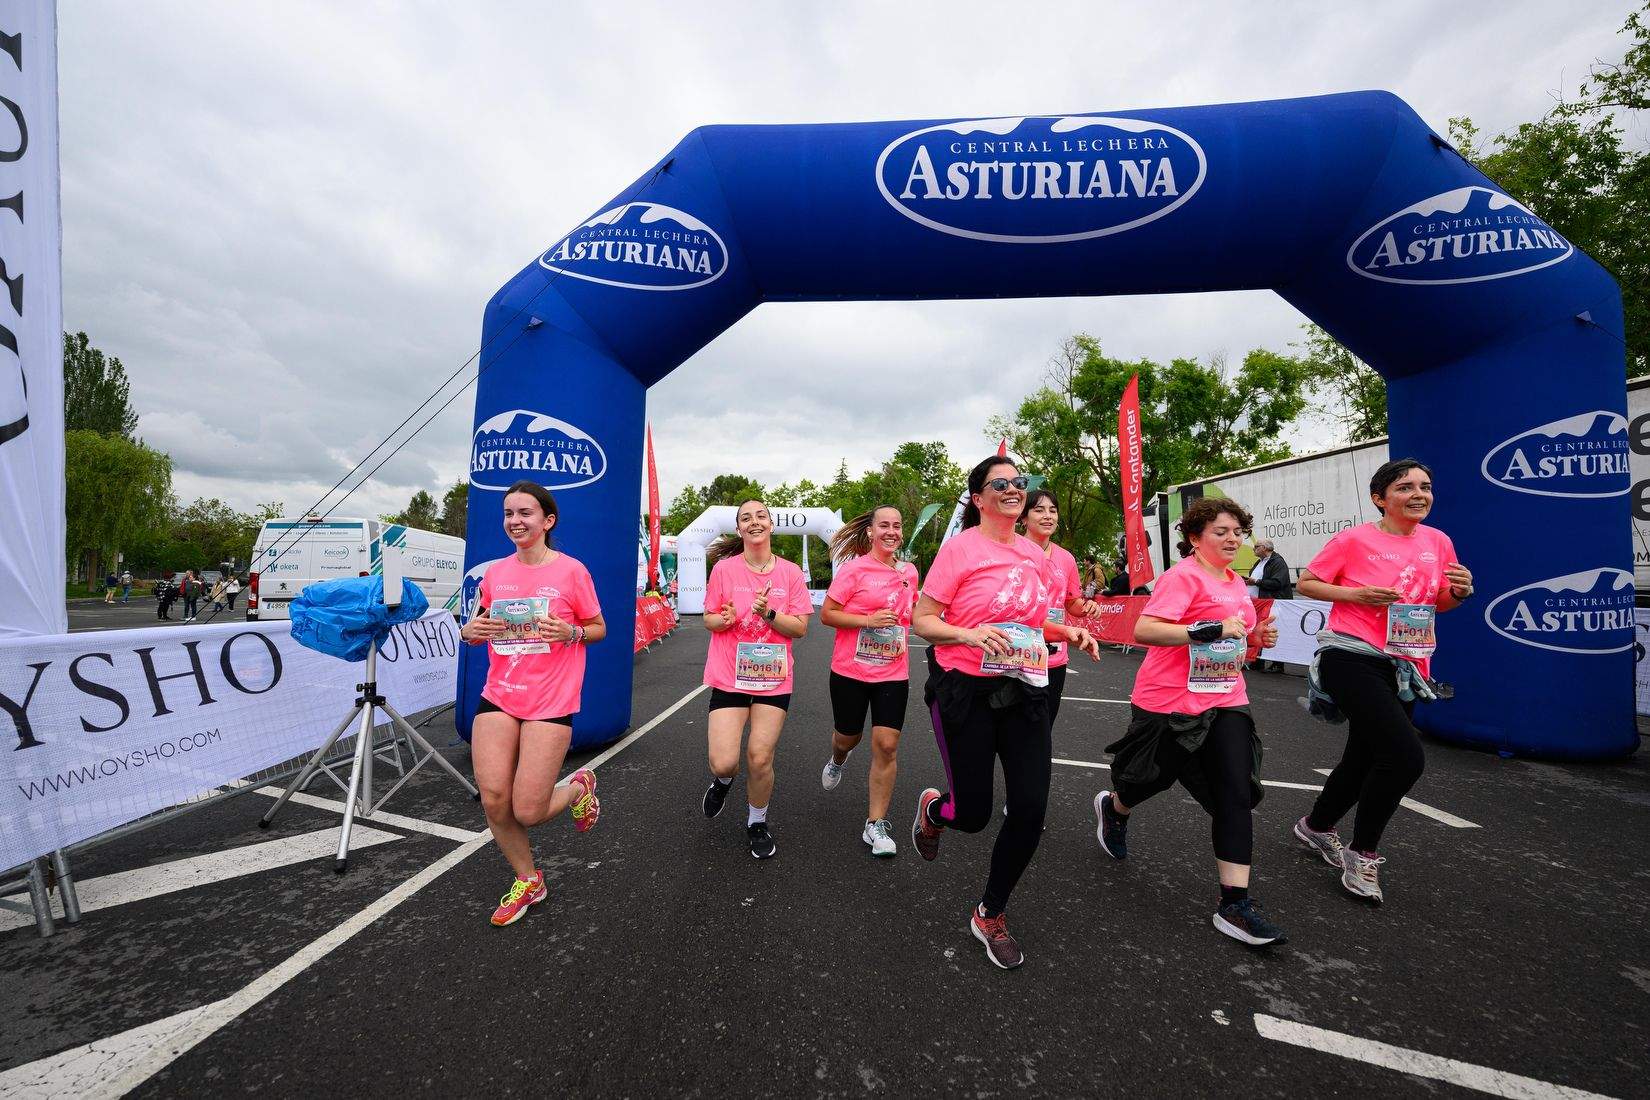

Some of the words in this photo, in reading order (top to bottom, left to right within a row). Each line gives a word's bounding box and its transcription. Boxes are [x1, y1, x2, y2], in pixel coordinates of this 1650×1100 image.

[950, 141, 1052, 154] CENTRAL
[1062, 137, 1169, 152] LECHERA
[900, 145, 1179, 200] ASTURIANA
[1413, 216, 1491, 235] CENTRAL
[580, 229, 638, 239] CENTRAL
[644, 229, 709, 246] LECHERA
[547, 237, 713, 275] ASTURIANA
[1365, 227, 1568, 270] ASTURIANA
[481, 438, 526, 448] CENTRAL
[531, 438, 590, 452] LECHERA
[1541, 440, 1609, 453] CENTRAL
[470, 443, 595, 476] ASTURIANA
[1264, 500, 1325, 521] Alfarroba
[1264, 522, 1297, 538] 100%
[1301, 515, 1357, 536] Natural
[412, 556, 435, 568] GRUPO
[436, 559, 458, 570] ELEYCO
[1544, 597, 1613, 608] CENTRAL
[18, 728, 222, 801] WWW.OYSHO.COM
